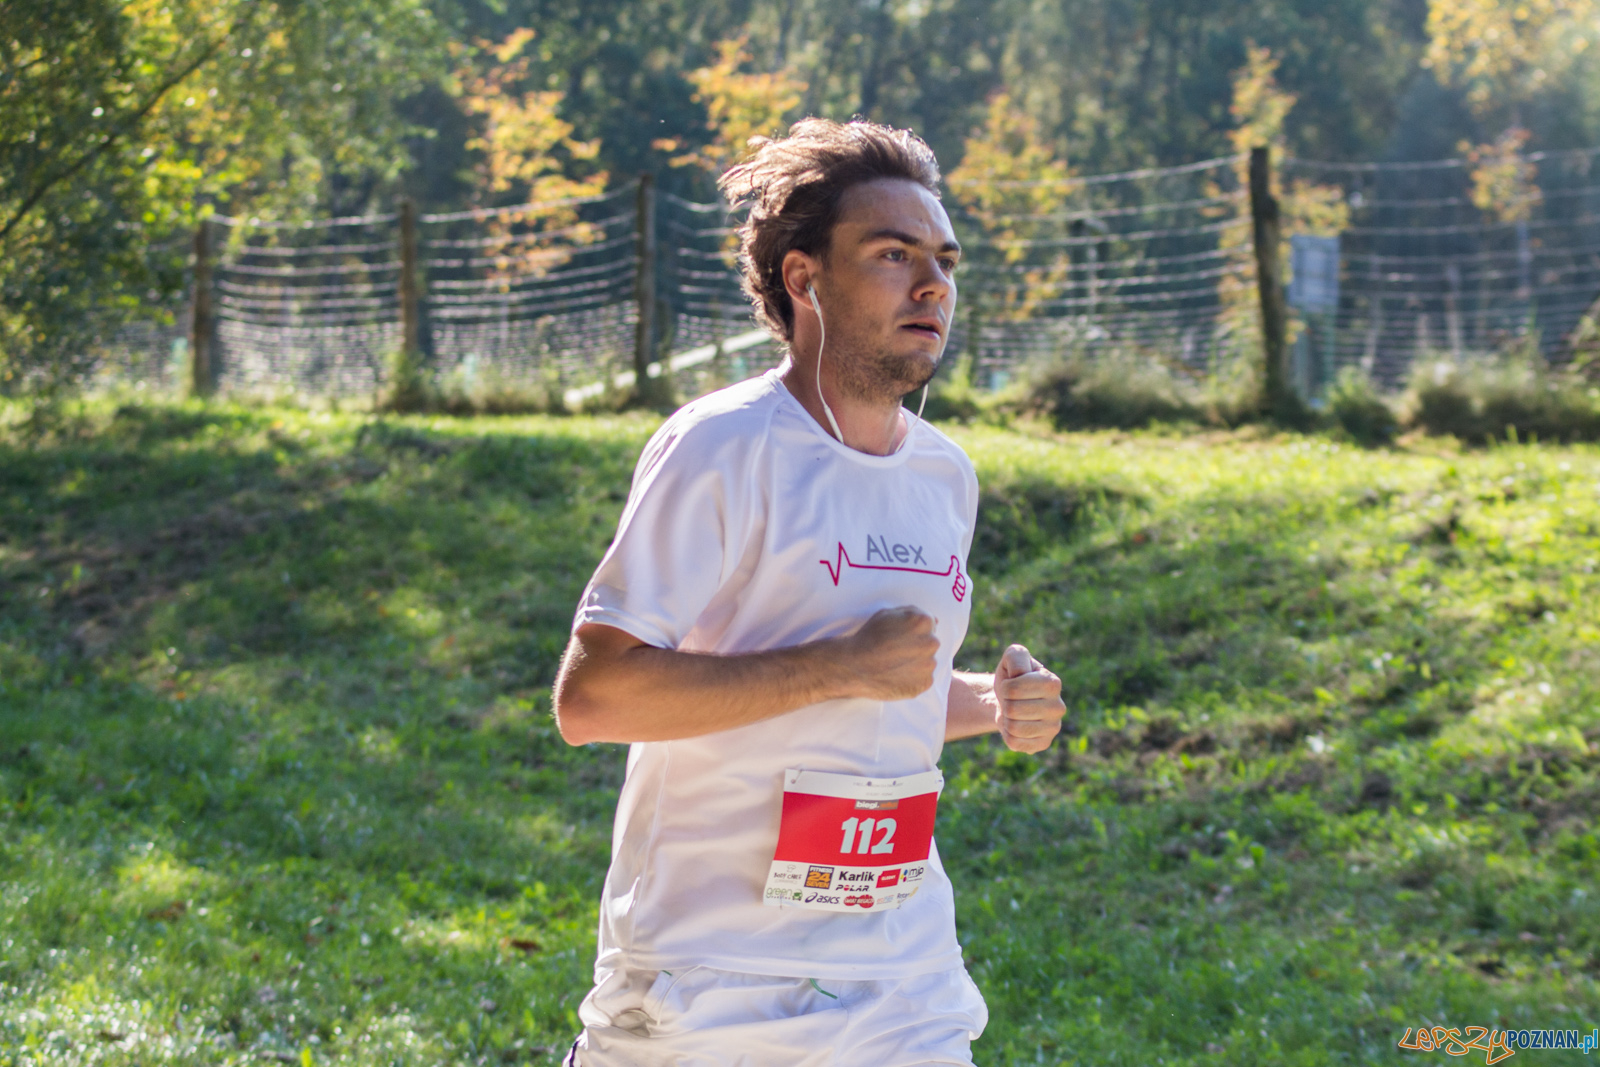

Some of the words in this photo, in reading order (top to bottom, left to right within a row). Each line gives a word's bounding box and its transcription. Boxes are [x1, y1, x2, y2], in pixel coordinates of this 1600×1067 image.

[866, 533, 928, 567] Alex
[840, 817, 897, 855] 112
[807, 871, 831, 883] 24
[838, 870, 875, 882] Karlik
[805, 880, 830, 888] SEVEN
[835, 884, 869, 892] POLAR
[765, 887, 793, 899] green
